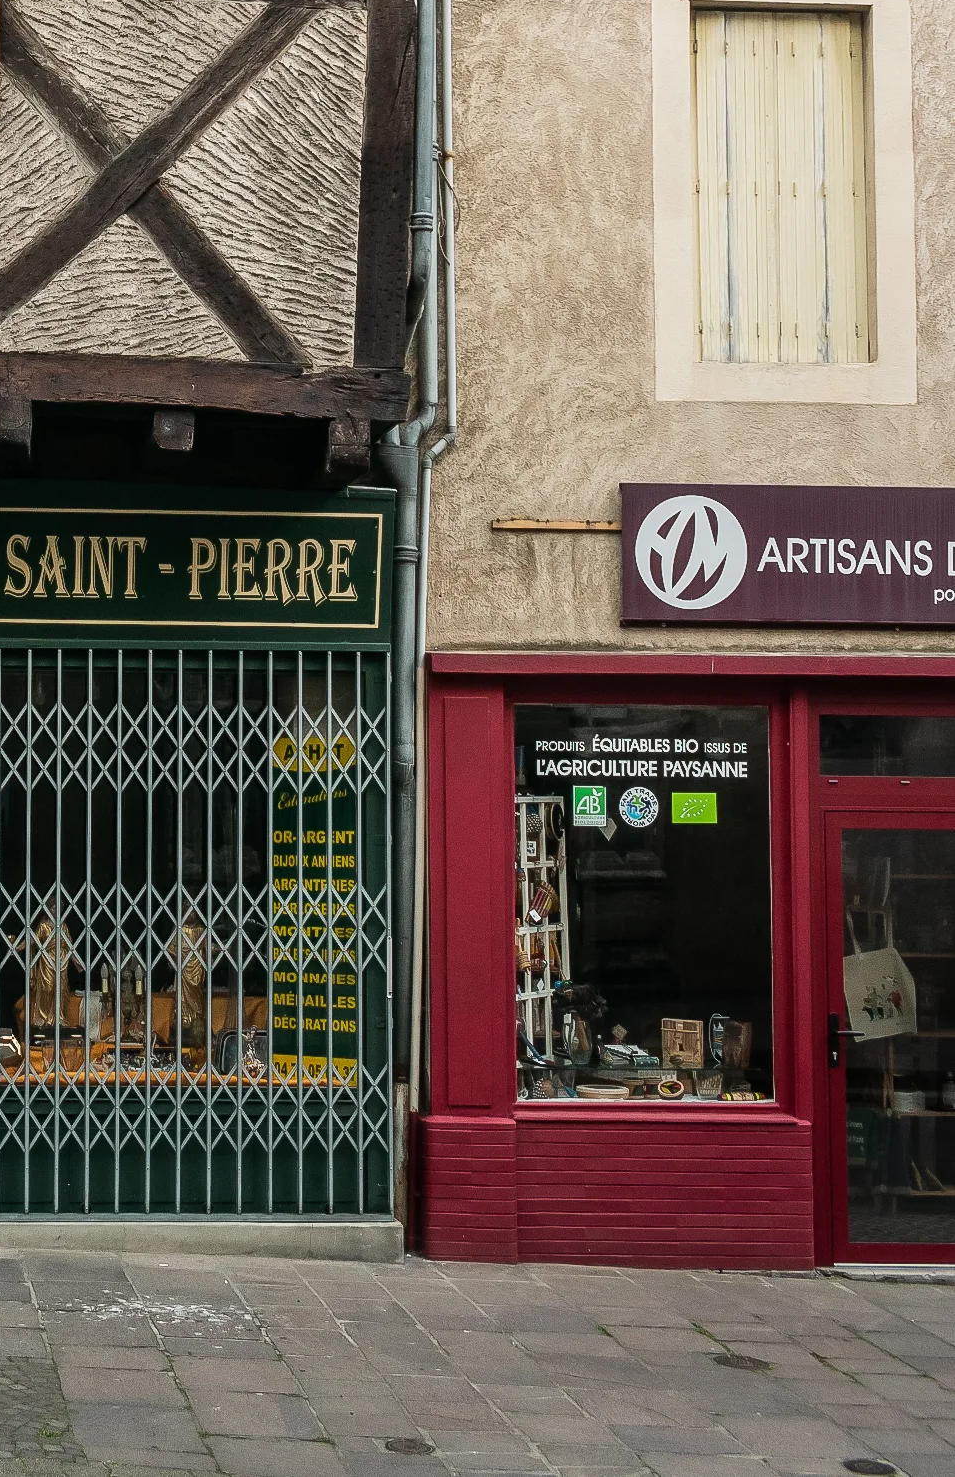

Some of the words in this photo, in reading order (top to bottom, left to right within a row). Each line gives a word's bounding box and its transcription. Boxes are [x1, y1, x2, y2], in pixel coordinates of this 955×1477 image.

[757, 536, 933, 576] ARTISANS
[3, 533, 148, 599] SAINT
[187, 537, 358, 607] PIERRE
[283, 743, 345, 761] AHT
[535, 740, 586, 752] PRODUITS
[592, 733, 671, 753] ÉQUITABLES
[674, 739, 699, 753] BIO
[703, 742, 731, 754] ISSUS
[733, 742, 748, 754] DE
[536, 758, 658, 777] L'AGRICULTURE
[663, 760, 748, 778] PAYSANNE
[576, 795, 601, 815] AB
[620, 789, 634, 808] FAIR
[634, 788, 658, 807] TRADE
[273, 830, 355, 844] OR-RGNT
[273, 854, 309, 868] BIJOX
[311, 855, 355, 868] ANIENS
[274, 878, 355, 892] ARGNTEIES
[274, 925, 355, 938] MONTES
[274, 990, 356, 1008] MÉAILES
[274, 1013, 357, 1033] DÉCRATONS
